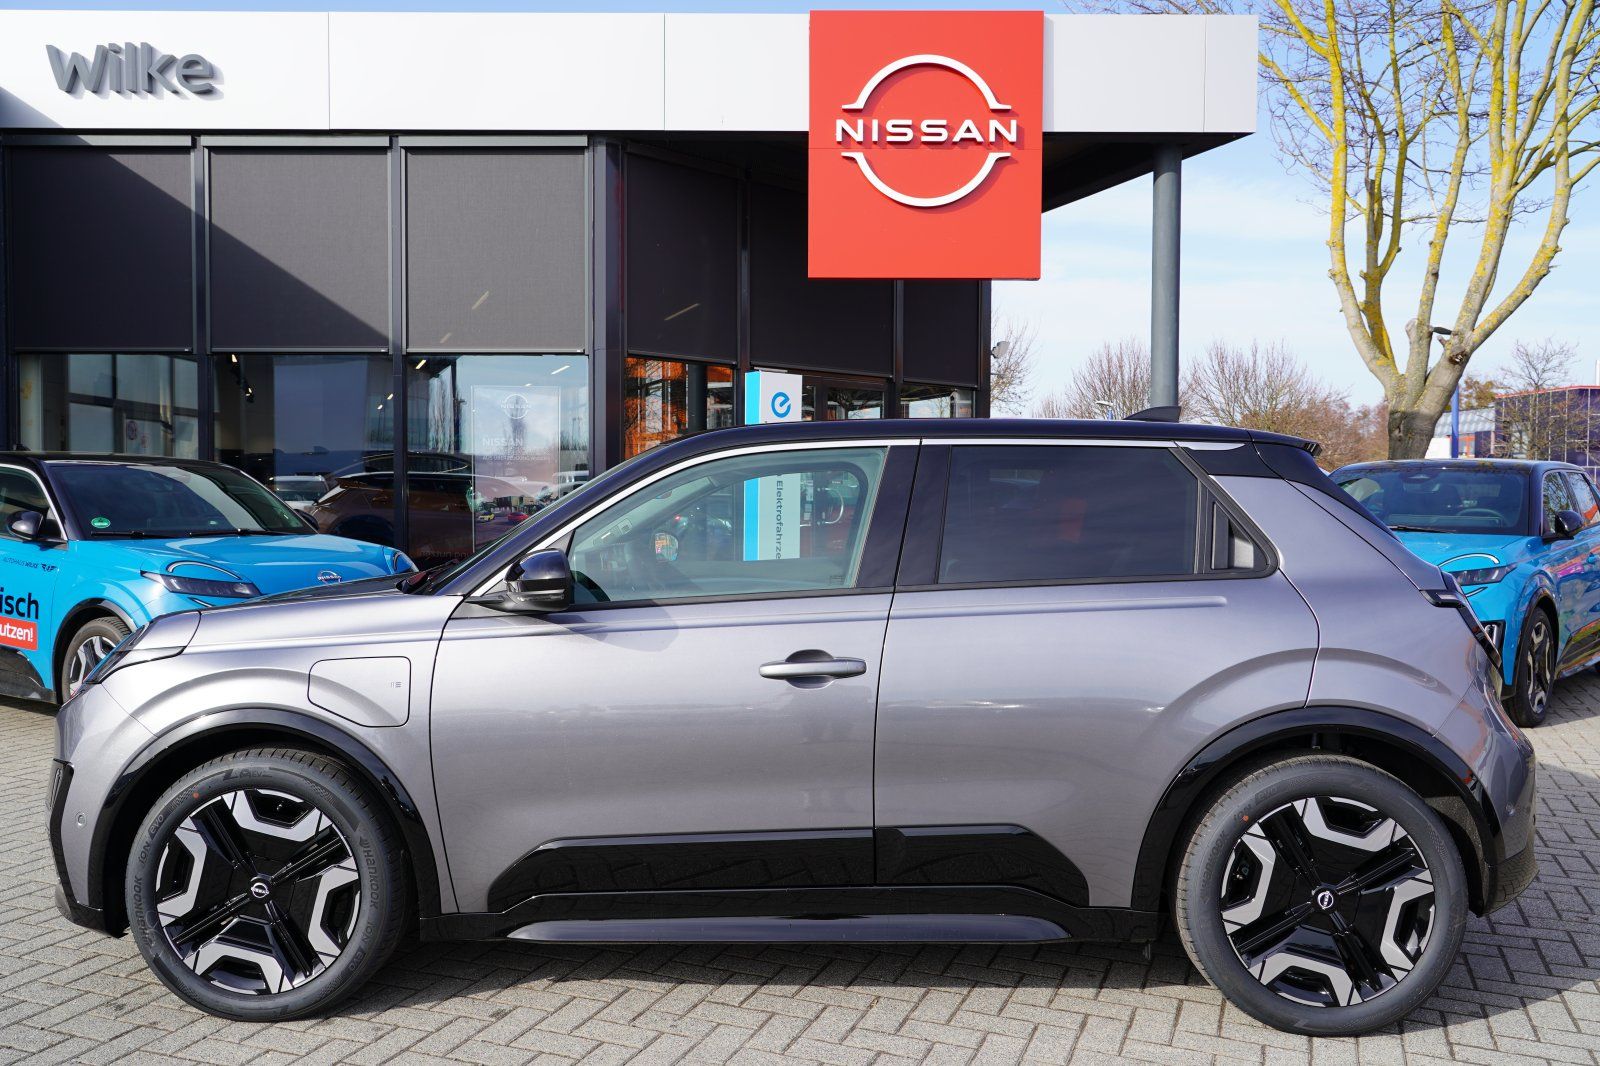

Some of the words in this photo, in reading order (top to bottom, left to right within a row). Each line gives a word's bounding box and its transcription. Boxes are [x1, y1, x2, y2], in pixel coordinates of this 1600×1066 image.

[45, 42, 216, 95] Wilke
[835, 118, 1018, 143] NISSAN
[149, 814, 165, 835] evo
